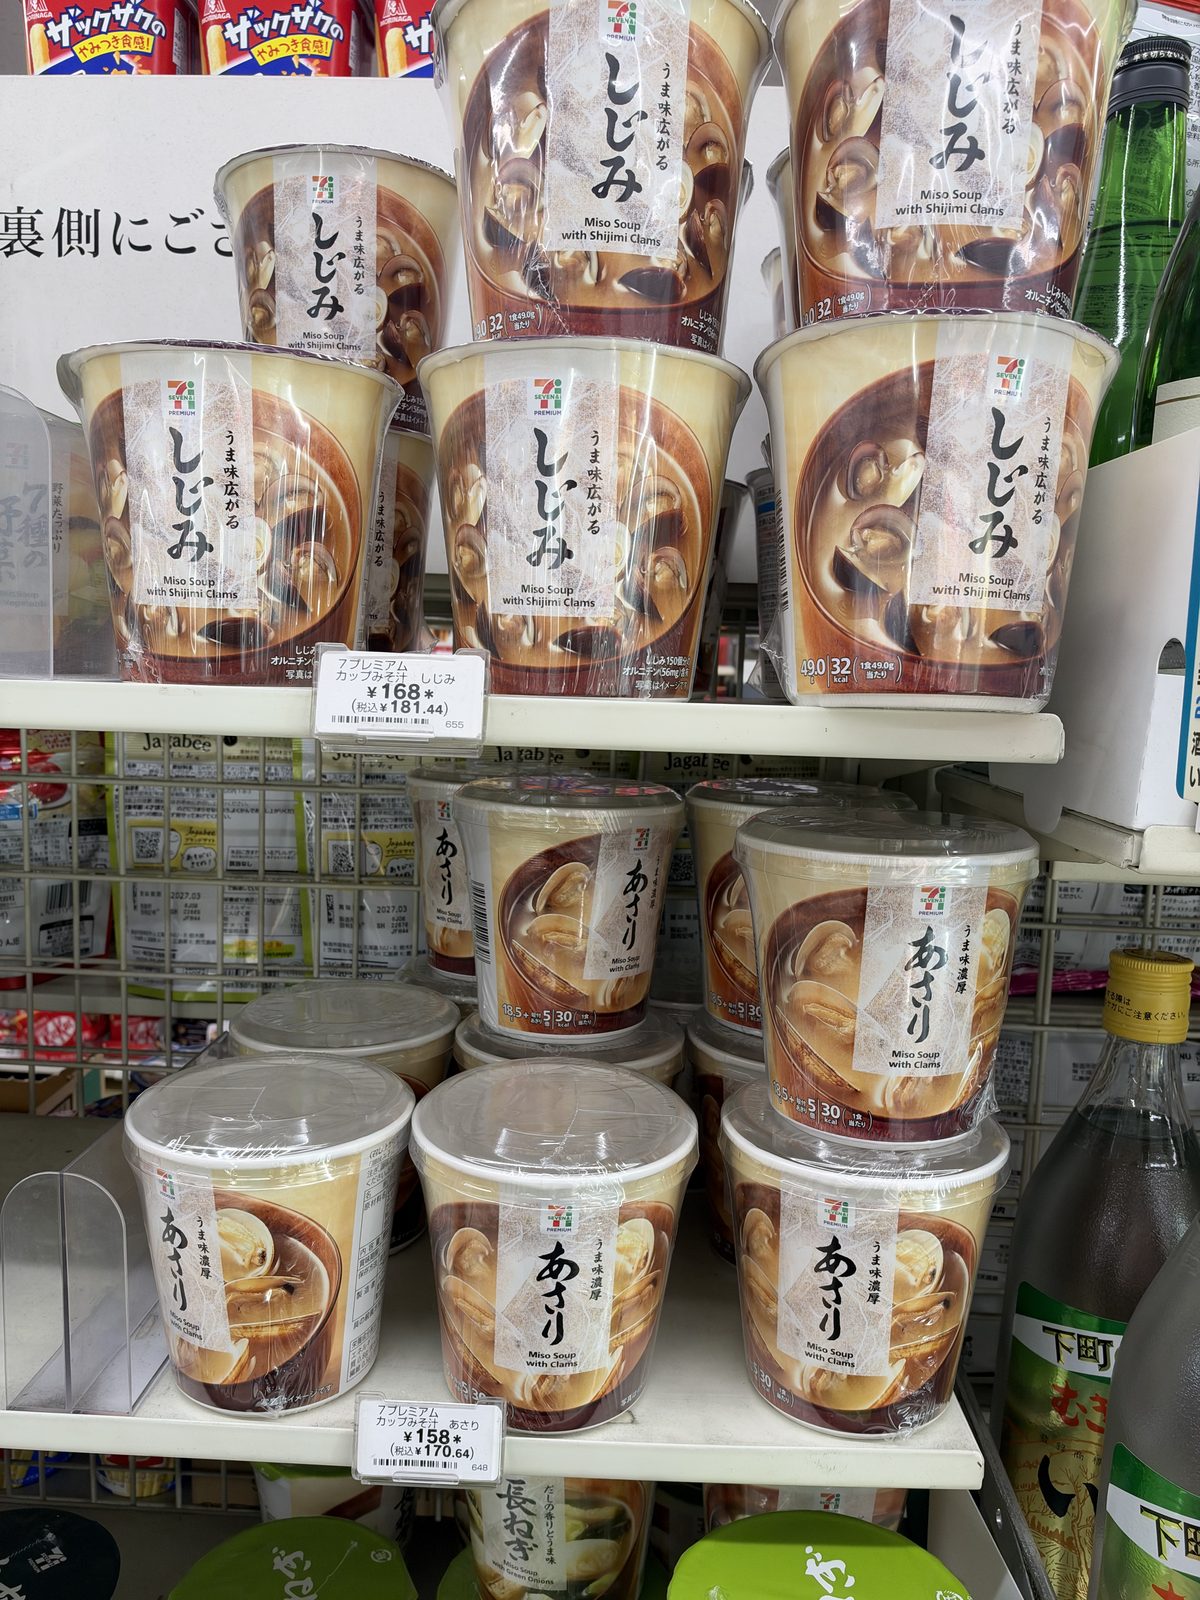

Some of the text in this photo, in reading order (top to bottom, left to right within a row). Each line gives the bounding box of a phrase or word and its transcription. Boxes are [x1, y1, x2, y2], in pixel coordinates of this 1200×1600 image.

[78, 35, 150, 58] やみつき食感!
[256, 40, 329, 61] やみつき食感!
[929, 14, 985, 172] しじみ
[655, 62, 672, 171] うま味広がる
[591, 52, 648, 202] しじみ
[920, 189, 982, 201] Miso Soup
[895, 203, 1004, 217] with Shijimi Clams
[584, 217, 641, 231] Miso Soup
[562, 231, 661, 247] with Shijimi Clams
[353, 216, 365, 295] うま味広がる
[307, 212, 346, 320] しじみ
[303, 331, 344, 342] Miso Soup
[288, 341, 362, 352] with Shijimi Clams
[1032, 417, 1051, 525] うま味広がる
[223, 430, 240, 530] うま味広がる
[586, 430, 603, 535] うま味広がる
[968, 406, 1029, 559] しじみ
[167, 426, 214, 562] しじみ
[526, 427, 578, 570] しじみ
[373, 490, 387, 567] うま味広がる
[163, 576, 215, 588] Miso Soup
[958, 572, 1014, 587] Miso Soup
[146, 587, 238, 600] with Shijimi Clams
[521, 584, 574, 596] Miso Soup
[932, 586, 1031, 602] with Shijimi Clams
[502, 596, 596, 608] with Shijimi Clams
[338, 658, 408, 672] 7プレミアム
[831, 657, 851, 675] 32
[335, 671, 456, 686] カップみそ汁 しじみ
[351, 698, 449, 718] (税込¥181.44)
[445, 720, 465, 729] 655
[435, 827, 458, 906] あさり
[376, 904, 408, 914] 2027.03
[622, 858, 649, 951] あさり
[611, 954, 641, 965] Miso Soup
[954, 924, 972, 995] うま味濃厚
[609, 964, 624, 973] with
[904, 925, 949, 1044] あさり
[502, 1003, 522, 1019] 18.5
[543, 1010, 551, 1022] 5
[555, 1011, 573, 1022] 30
[891, 1050, 941, 1061] Miso Soup
[888, 1060, 941, 1070] with Clams
[807, 1098, 816, 1113] 5
[821, 1102, 841, 1119] 30
[823, 1219, 848, 1229] PREMIUM
[197, 1215, 213, 1280] うま味濃厚
[160, 1206, 188, 1311] あさり
[589, 1238, 604, 1301] うま味濃厚
[866, 1241, 883, 1305] うま味濃厚
[536, 1240, 580, 1346] あさり
[814, 1235, 857, 1341] あさり
[182, 1316, 201, 1332] Soup
[182, 1326, 203, 1342] Clams
[528, 1350, 577, 1361] Miso Soup
[806, 1341, 854, 1360] Miso Soup
[1042, 1325, 1114, 1372] 下町
[525, 1360, 578, 1368] with Clams
[804, 1350, 856, 1369] with Clams
[760, 1367, 772, 1388] 30
[377, 1405, 438, 1418] 7プレミアム
[376, 1417, 480, 1431] カップみそ汁 あさり
[391, 1443, 475, 1460] (税込¥170.64)
[471, 1463, 488, 1472] 648
[496, 1479, 539, 1562] 長ねぎ
[543, 1484, 557, 1566] だしの香りとうま味
[491, 1559, 554, 1586] with Green Onions
[503, 1559, 538, 1577] Miso Soup
